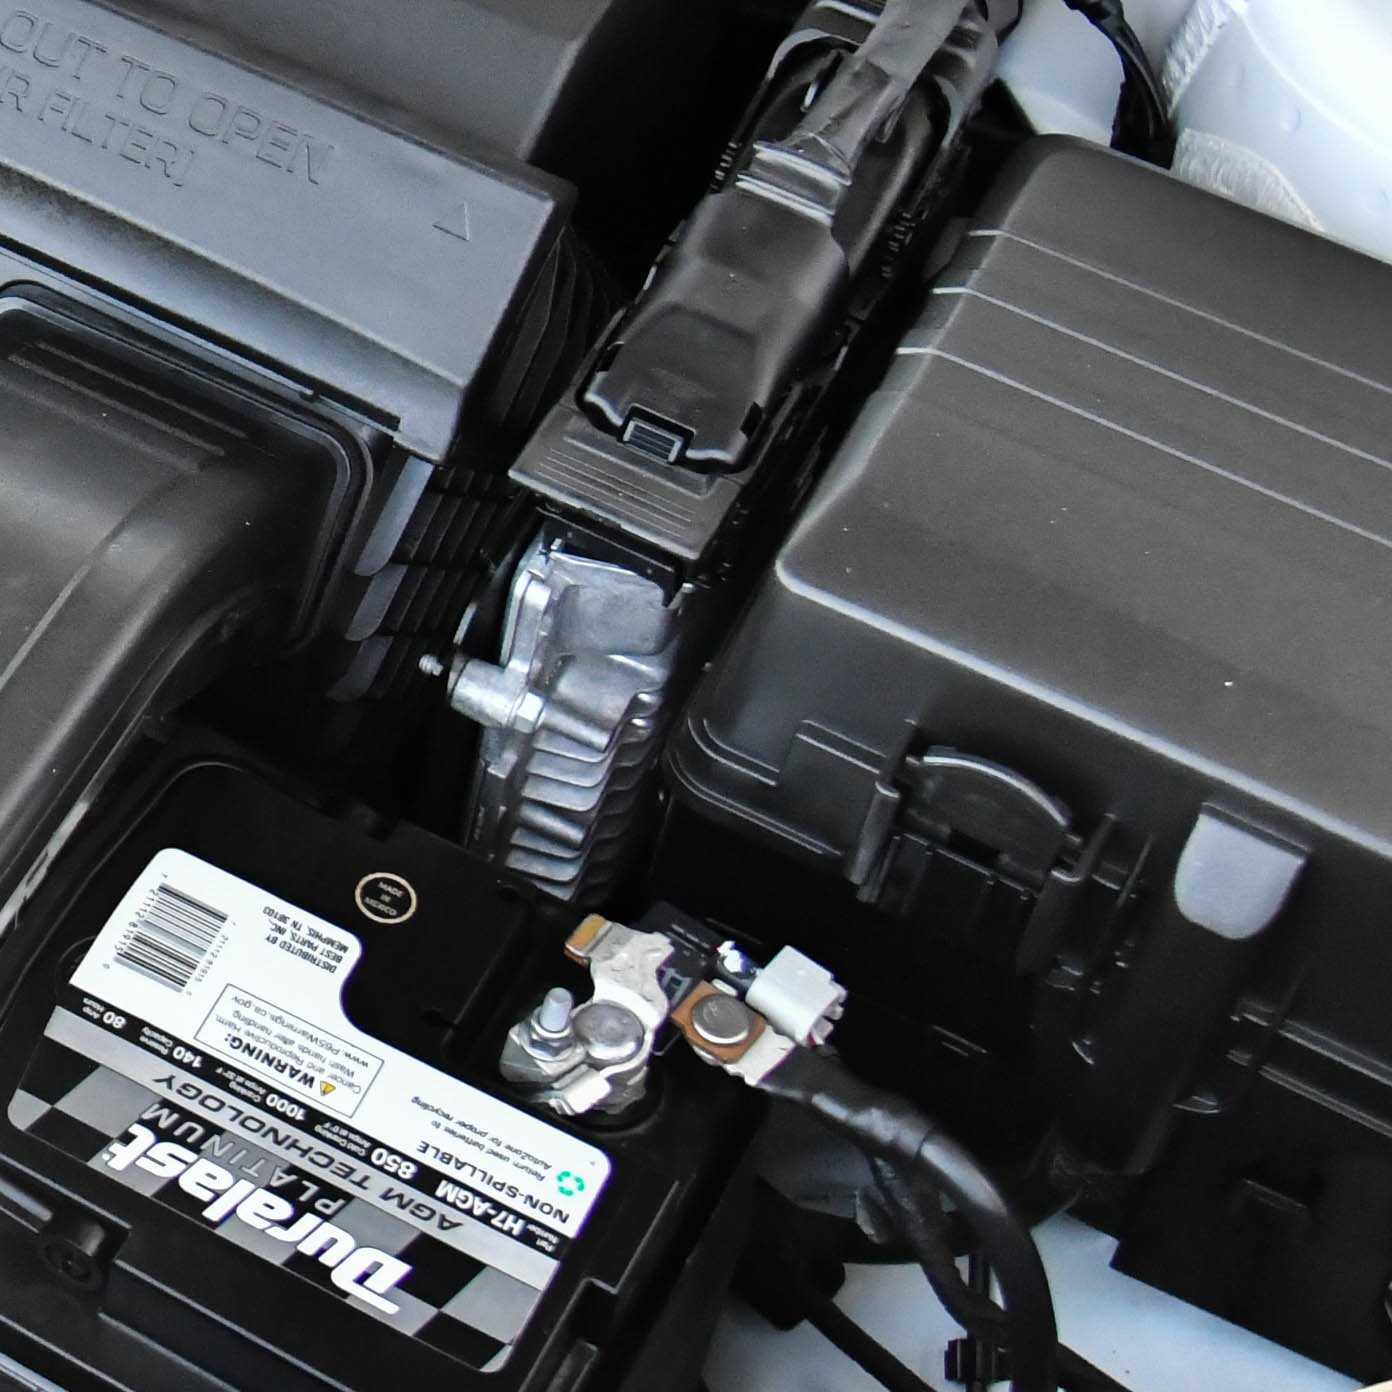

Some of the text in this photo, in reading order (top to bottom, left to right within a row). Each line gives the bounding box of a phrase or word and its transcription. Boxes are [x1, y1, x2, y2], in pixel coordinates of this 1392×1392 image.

[114, 54, 182, 117] TO
[184, 88, 336, 186] OPEN
[35, 89, 196, 188] FILTER)
[290, 920, 303, 932] TN
[265, 934, 337, 974] DISTRIBUTED BY
[290, 930, 319, 952] PARTS,
[307, 927, 349, 954] MEMPHIS,
[319, 948, 344, 964] BEST
[102, 1011, 127, 1029] 80
[244, 1030, 305, 1066] Reproductive
[274, 1034, 296, 1046] after
[297, 1044, 327, 1064] hands
[172, 1046, 202, 1068] 140
[224, 1033, 315, 1089] WARNING:
[329, 1062, 355, 1078] Wash
[265, 1093, 306, 1121] 1000
[455, 1120, 489, 1138] proper
[487, 1137, 503, 1148] for
[140, 1100, 345, 1217] PLATINUM
[153, 1075, 463, 1231] AGM TECHNOLOGY
[370, 1147, 418, 1180] 850
[431, 1120, 546, 1182] Return used batteries to
[504, 1144, 553, 1170] AutoZone
[417, 1141, 570, 1224] NON-SPILLABLE
[103, 1121, 412, 1315] Duralast
[435, 1180, 525, 1236] H7-AGM
